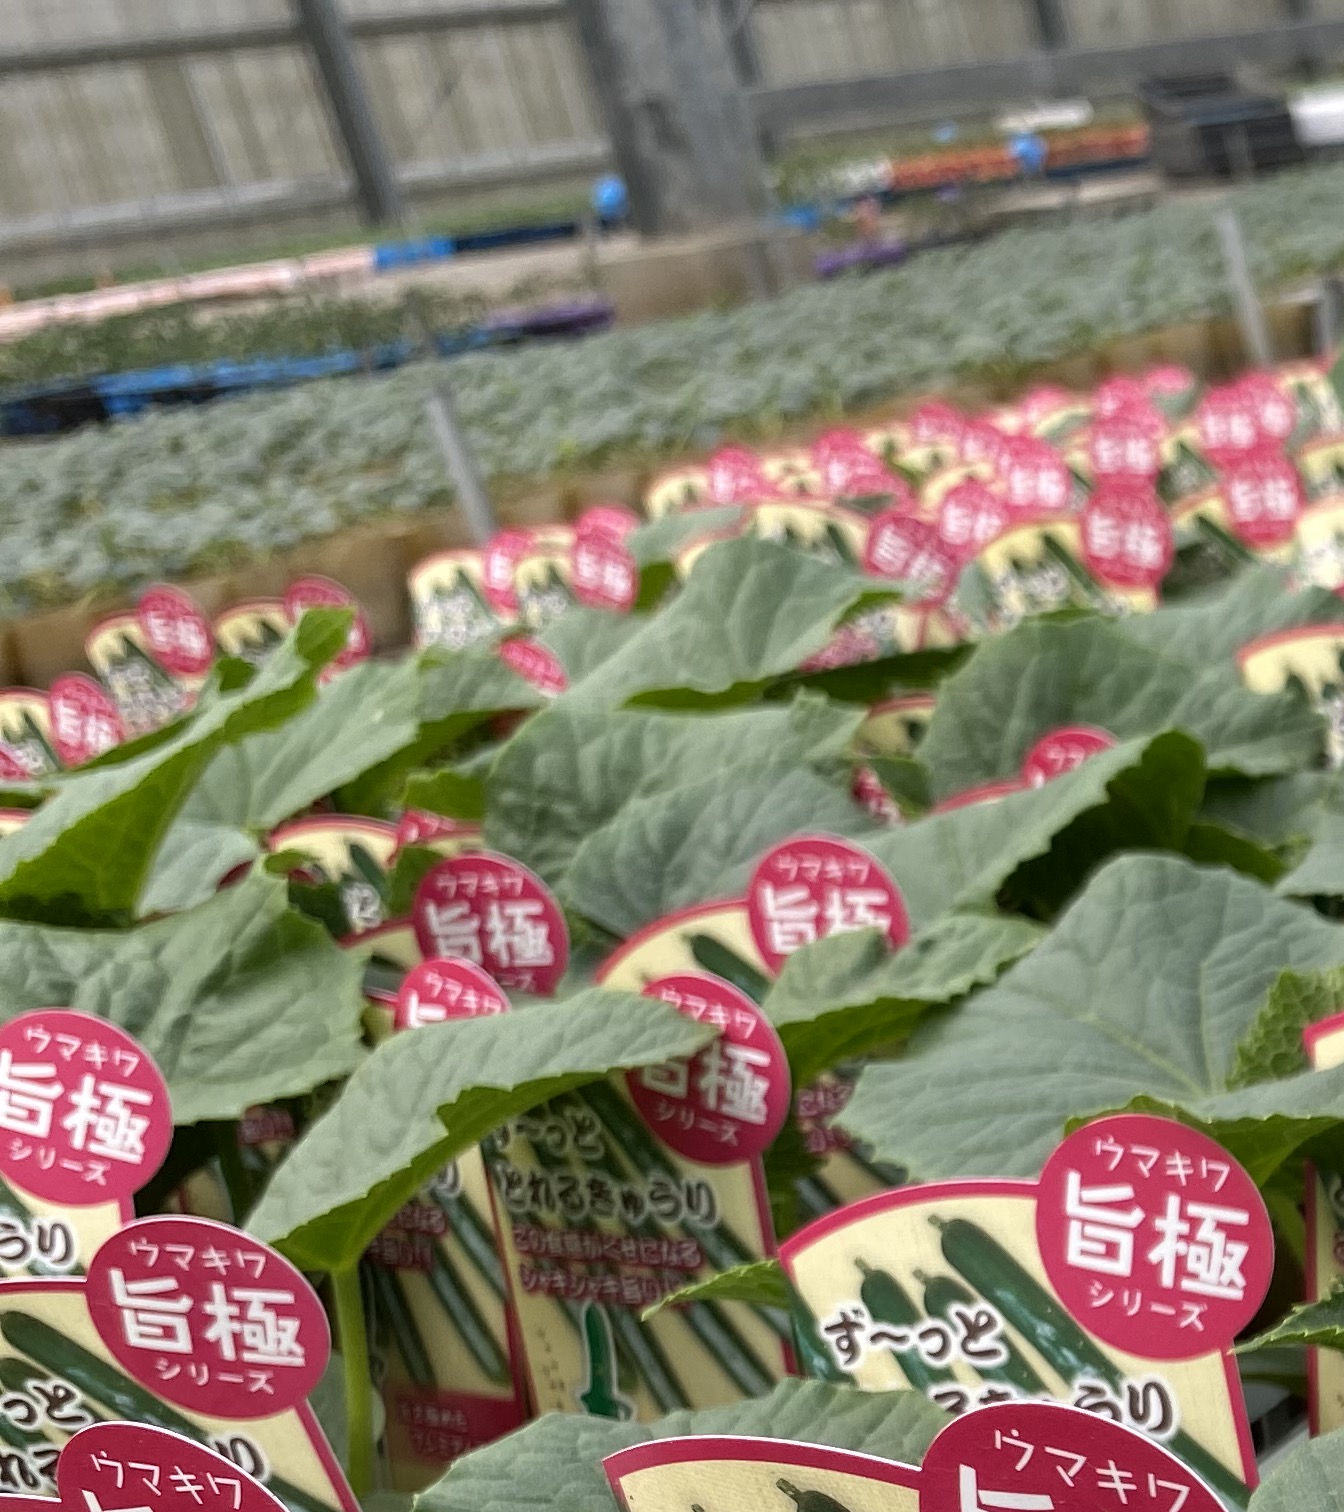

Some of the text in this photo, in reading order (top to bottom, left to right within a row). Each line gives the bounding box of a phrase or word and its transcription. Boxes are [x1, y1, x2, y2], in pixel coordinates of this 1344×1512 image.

[436, 872, 525, 896] ウマキワ
[777, 855, 870, 882] ウマキワ
[425, 900, 556, 968] 旨極
[756, 883, 892, 954] 旨極
[659, 989, 758, 1038] ウマキワ
[24, 1024, 140, 1077] ウマキワ
[0, 1051, 153, 1165] 旨極
[650, 1099, 739, 1147] シリーズ
[8, 1139, 111, 1187] シリーズ
[1094, 1134, 1231, 1191] ウマキワ
[128, 1237, 266, 1279] ウマキワ
[1064, 1169, 1251, 1301] 旨極
[107, 1267, 306, 1368] 旨極
[1089, 1280, 1209, 1332] シリーズ
[154, 1358, 275, 1395] シリーズ
[91, 1452, 243, 1510] ウマキワ
